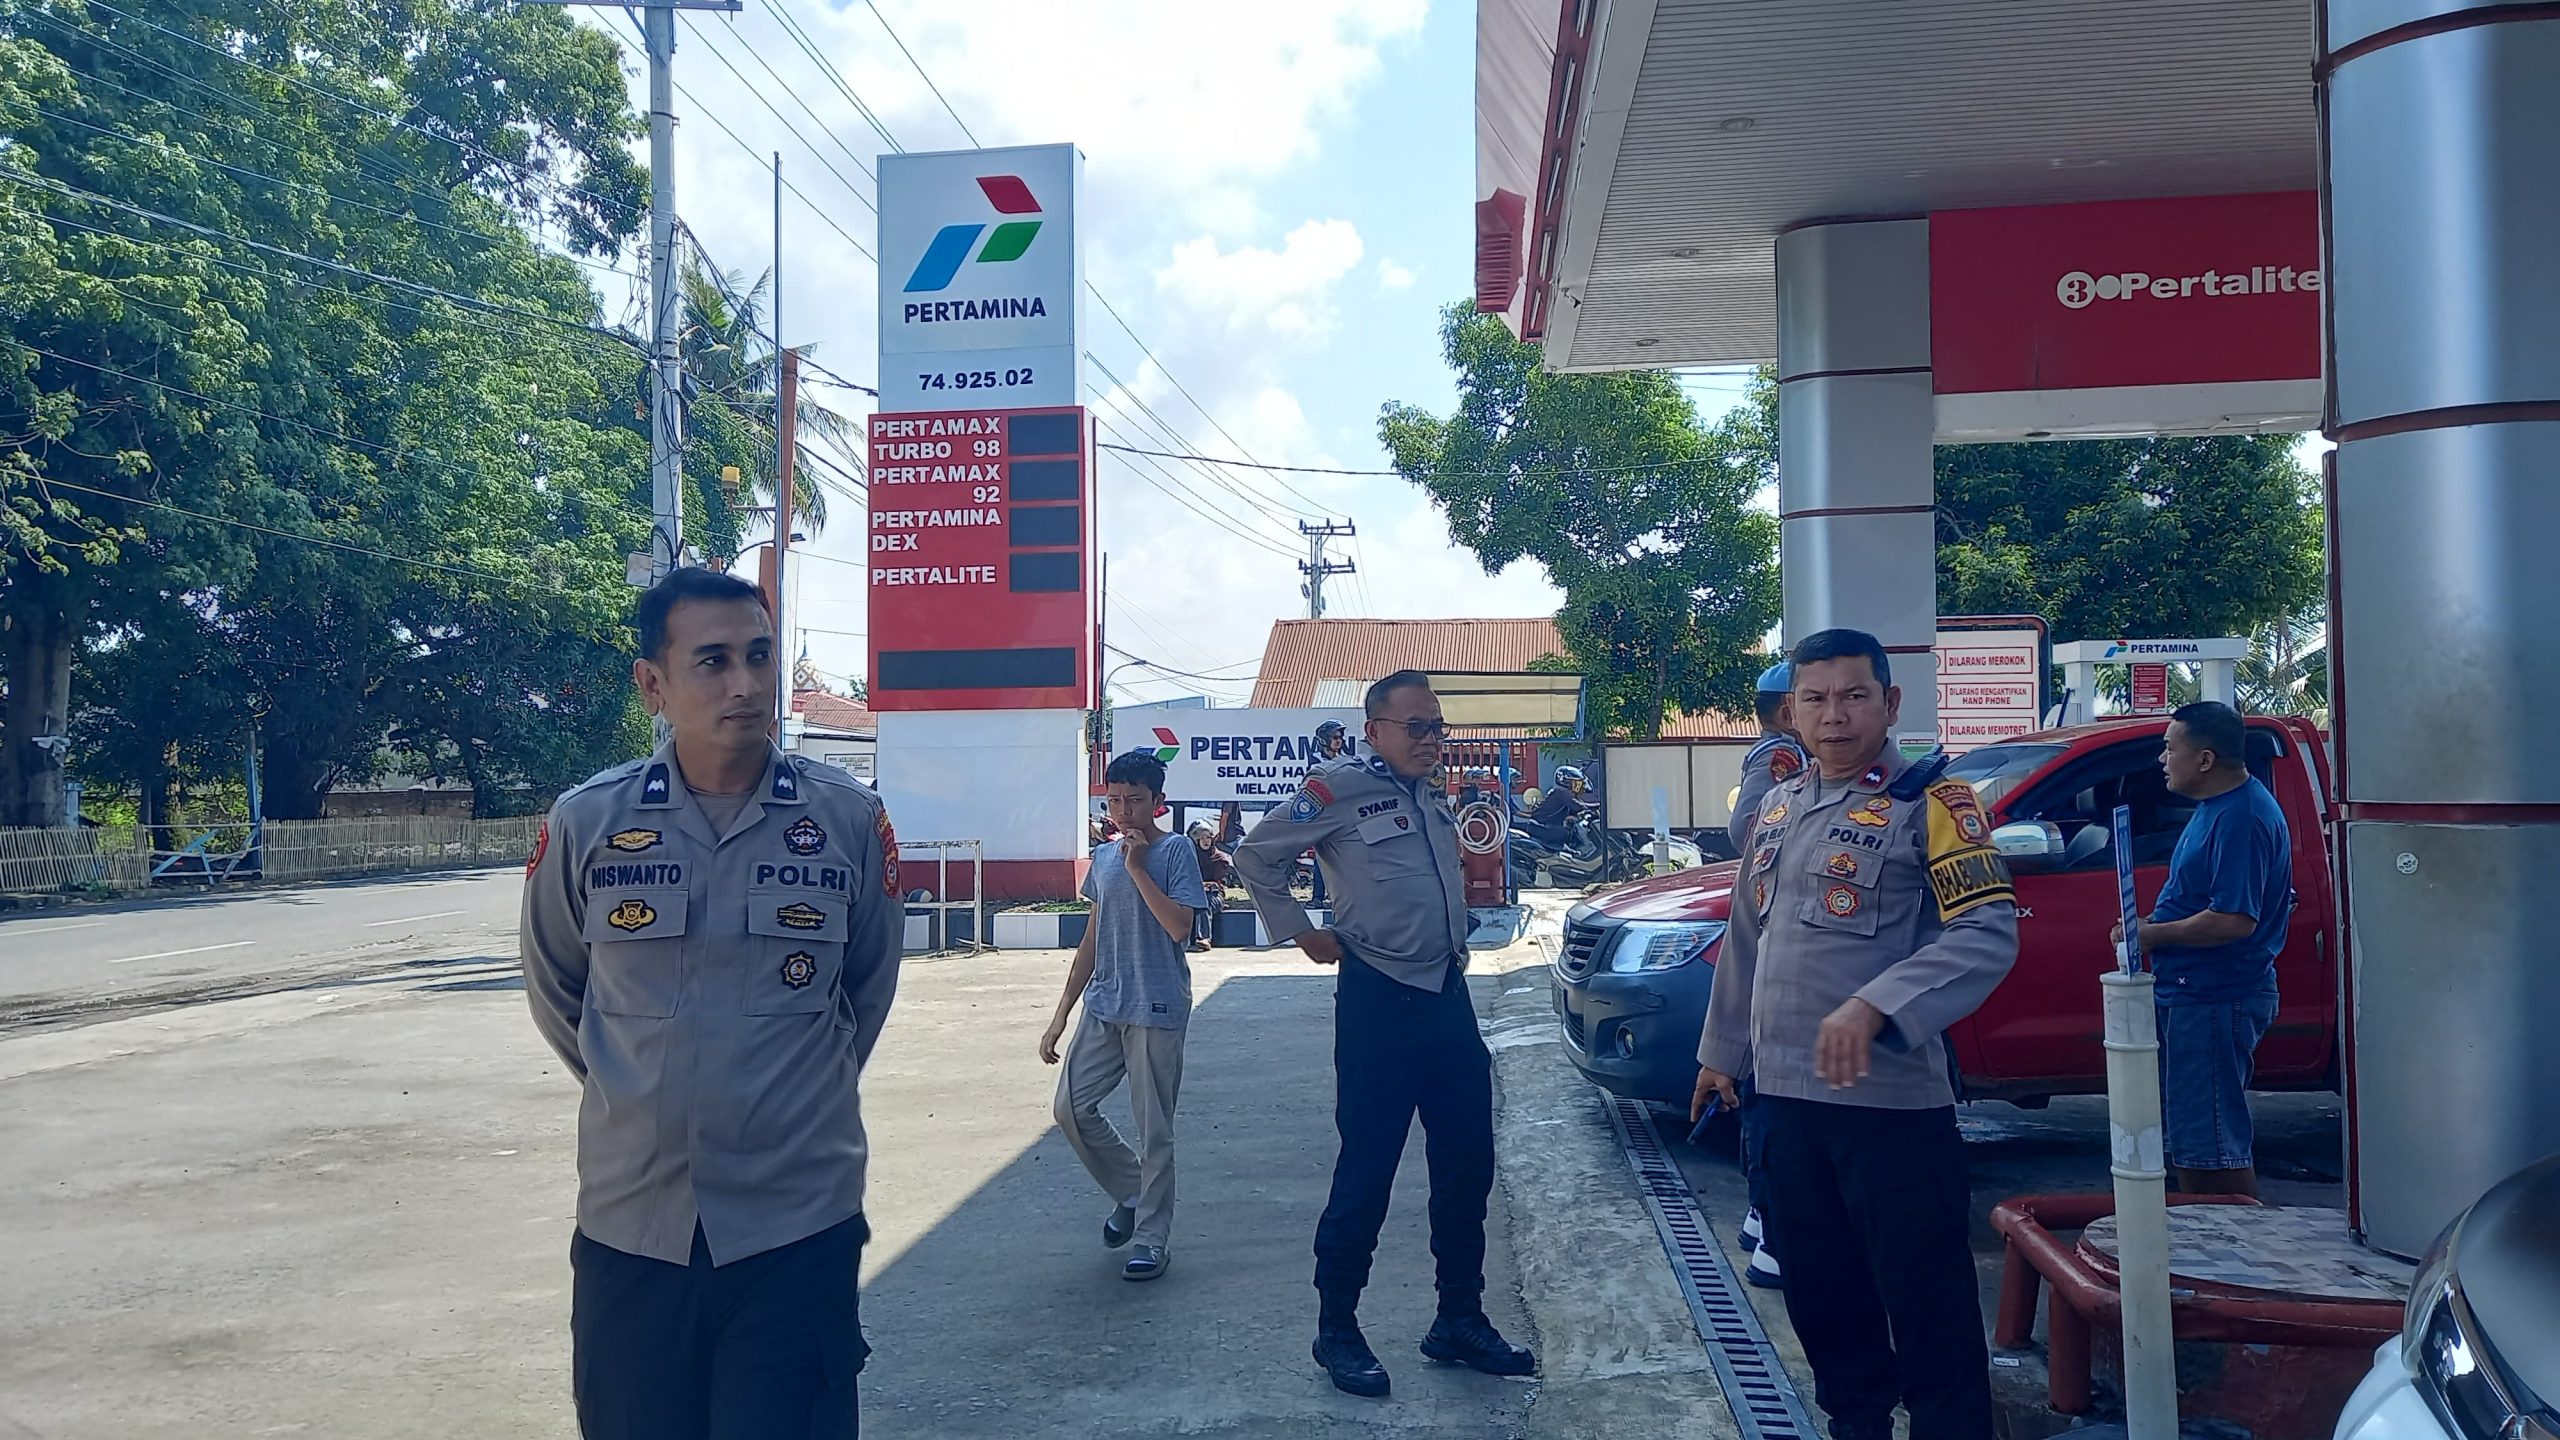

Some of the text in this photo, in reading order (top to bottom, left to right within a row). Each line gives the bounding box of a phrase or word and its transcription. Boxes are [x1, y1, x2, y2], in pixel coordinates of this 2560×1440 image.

[2120, 265, 2320, 300] Pertalite
[904, 297, 1047, 323] PERTAMINA
[919, 368, 1033, 391] 74.925.02
[873, 416, 1001, 438] PERTAMAX
[874, 440, 1001, 460] TURBO 98
[873, 463, 1001, 485] PERTAMAX
[973, 486, 1001, 504] 92
[872, 508, 1002, 529] PERTAMINA
[872, 533, 919, 552] DEX
[872, 566, 997, 586] PERTALITE
[2131, 643, 2199, 654] PERTAMINA
[1949, 656, 2026, 667] DILARANG MEROKOK
[1949, 687, 2027, 696] DILARANG MENGAKTIFKAN
[1962, 697, 2011, 705] HAND PHONE
[1950, 725, 2027, 736] DILARANG MEMOTRET
[1216, 766, 1307, 778] SELALU HA
[1235, 783, 1299, 795] MELAYA
[1358, 799, 1399, 817] SYARIF
[1828, 828, 1883, 850] POLRI
[591, 864, 681, 889] NISWANTO
[757, 864, 846, 891] POLRI
